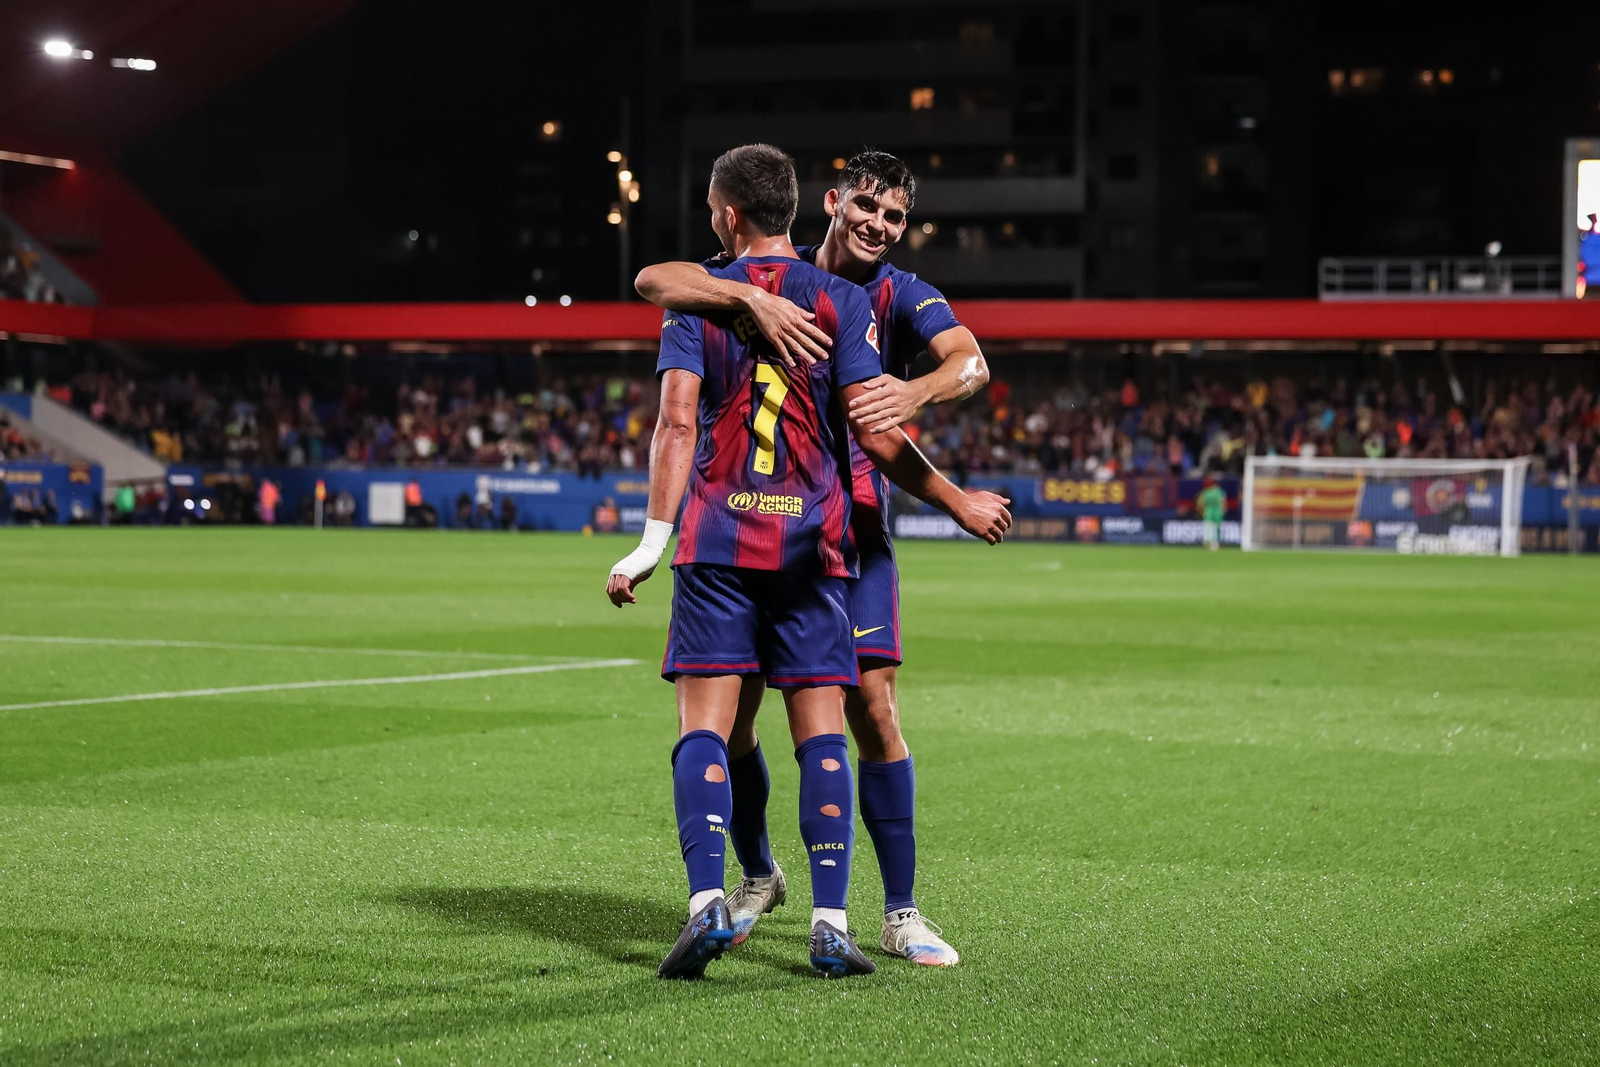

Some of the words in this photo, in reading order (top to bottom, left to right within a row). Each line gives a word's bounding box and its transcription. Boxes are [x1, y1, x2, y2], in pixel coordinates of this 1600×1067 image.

[732, 313, 758, 342] FE
[753, 363, 790, 475] 7
[759, 492, 803, 505] UNHCR
[757, 502, 803, 514] ACNUR
[811, 842, 845, 852] BARÇA
